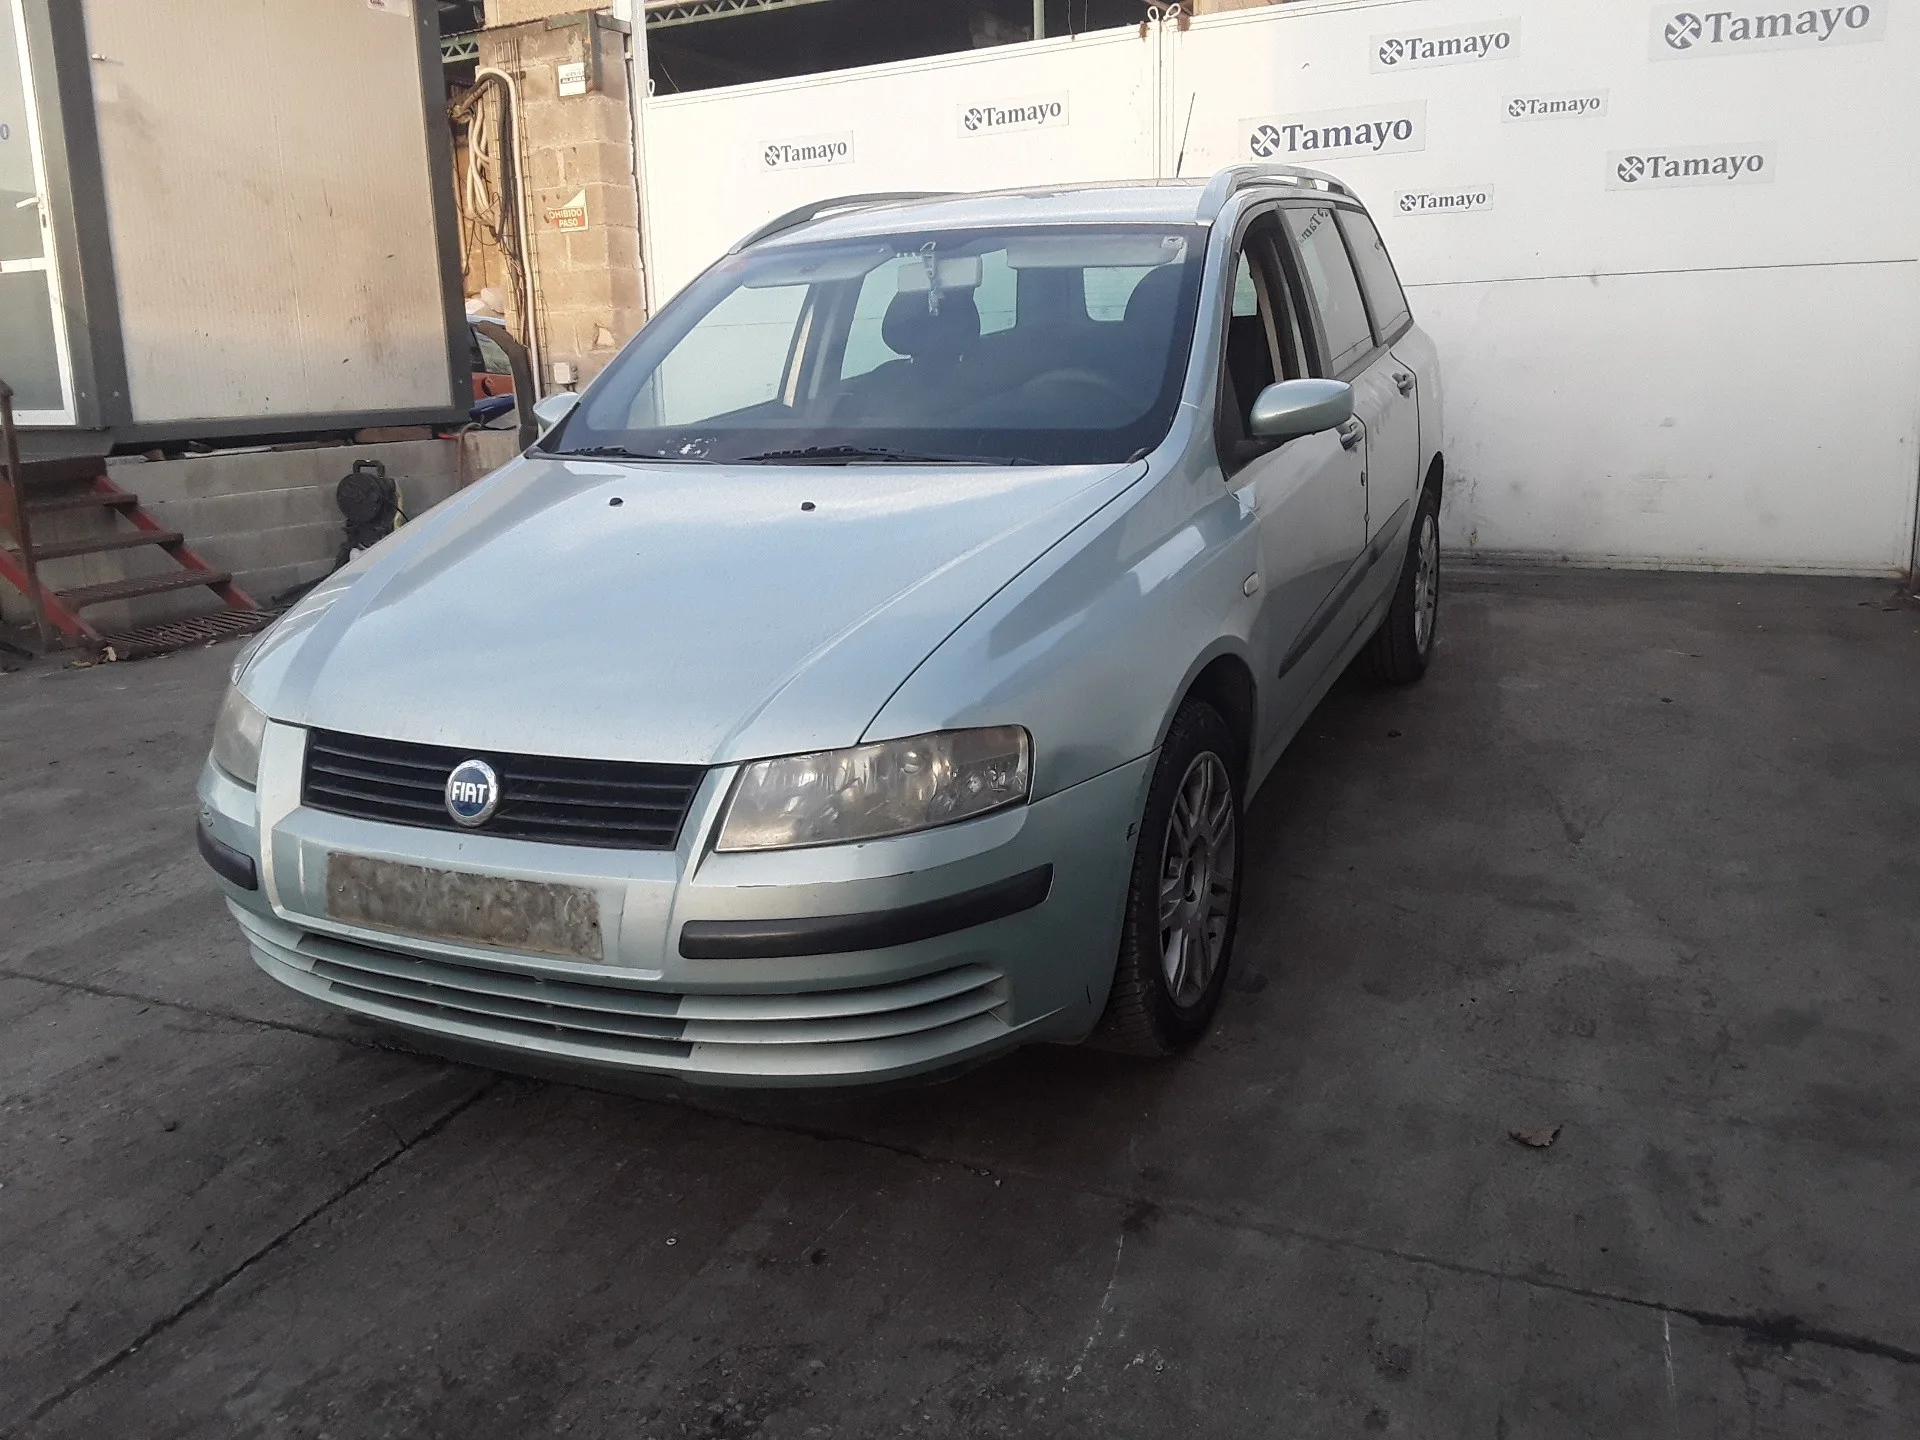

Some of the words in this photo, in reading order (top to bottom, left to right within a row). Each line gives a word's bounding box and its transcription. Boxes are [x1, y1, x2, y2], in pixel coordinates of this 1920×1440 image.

[1704, 4, 1870, 44] Tamayo
[1405, 32, 1510, 61] Tamayo
[983, 102, 1062, 127] Tamayo
[1527, 97, 1601, 115] Tamayo
[1281, 118, 1413, 152] Tamayo
[781, 141, 848, 163] Tamayo
[1647, 154, 1764, 180] Tamayo
[1416, 193, 1487, 210] Tamayo
[558, 217, 579, 228] PASO
[451, 780, 488, 804] FIAT
